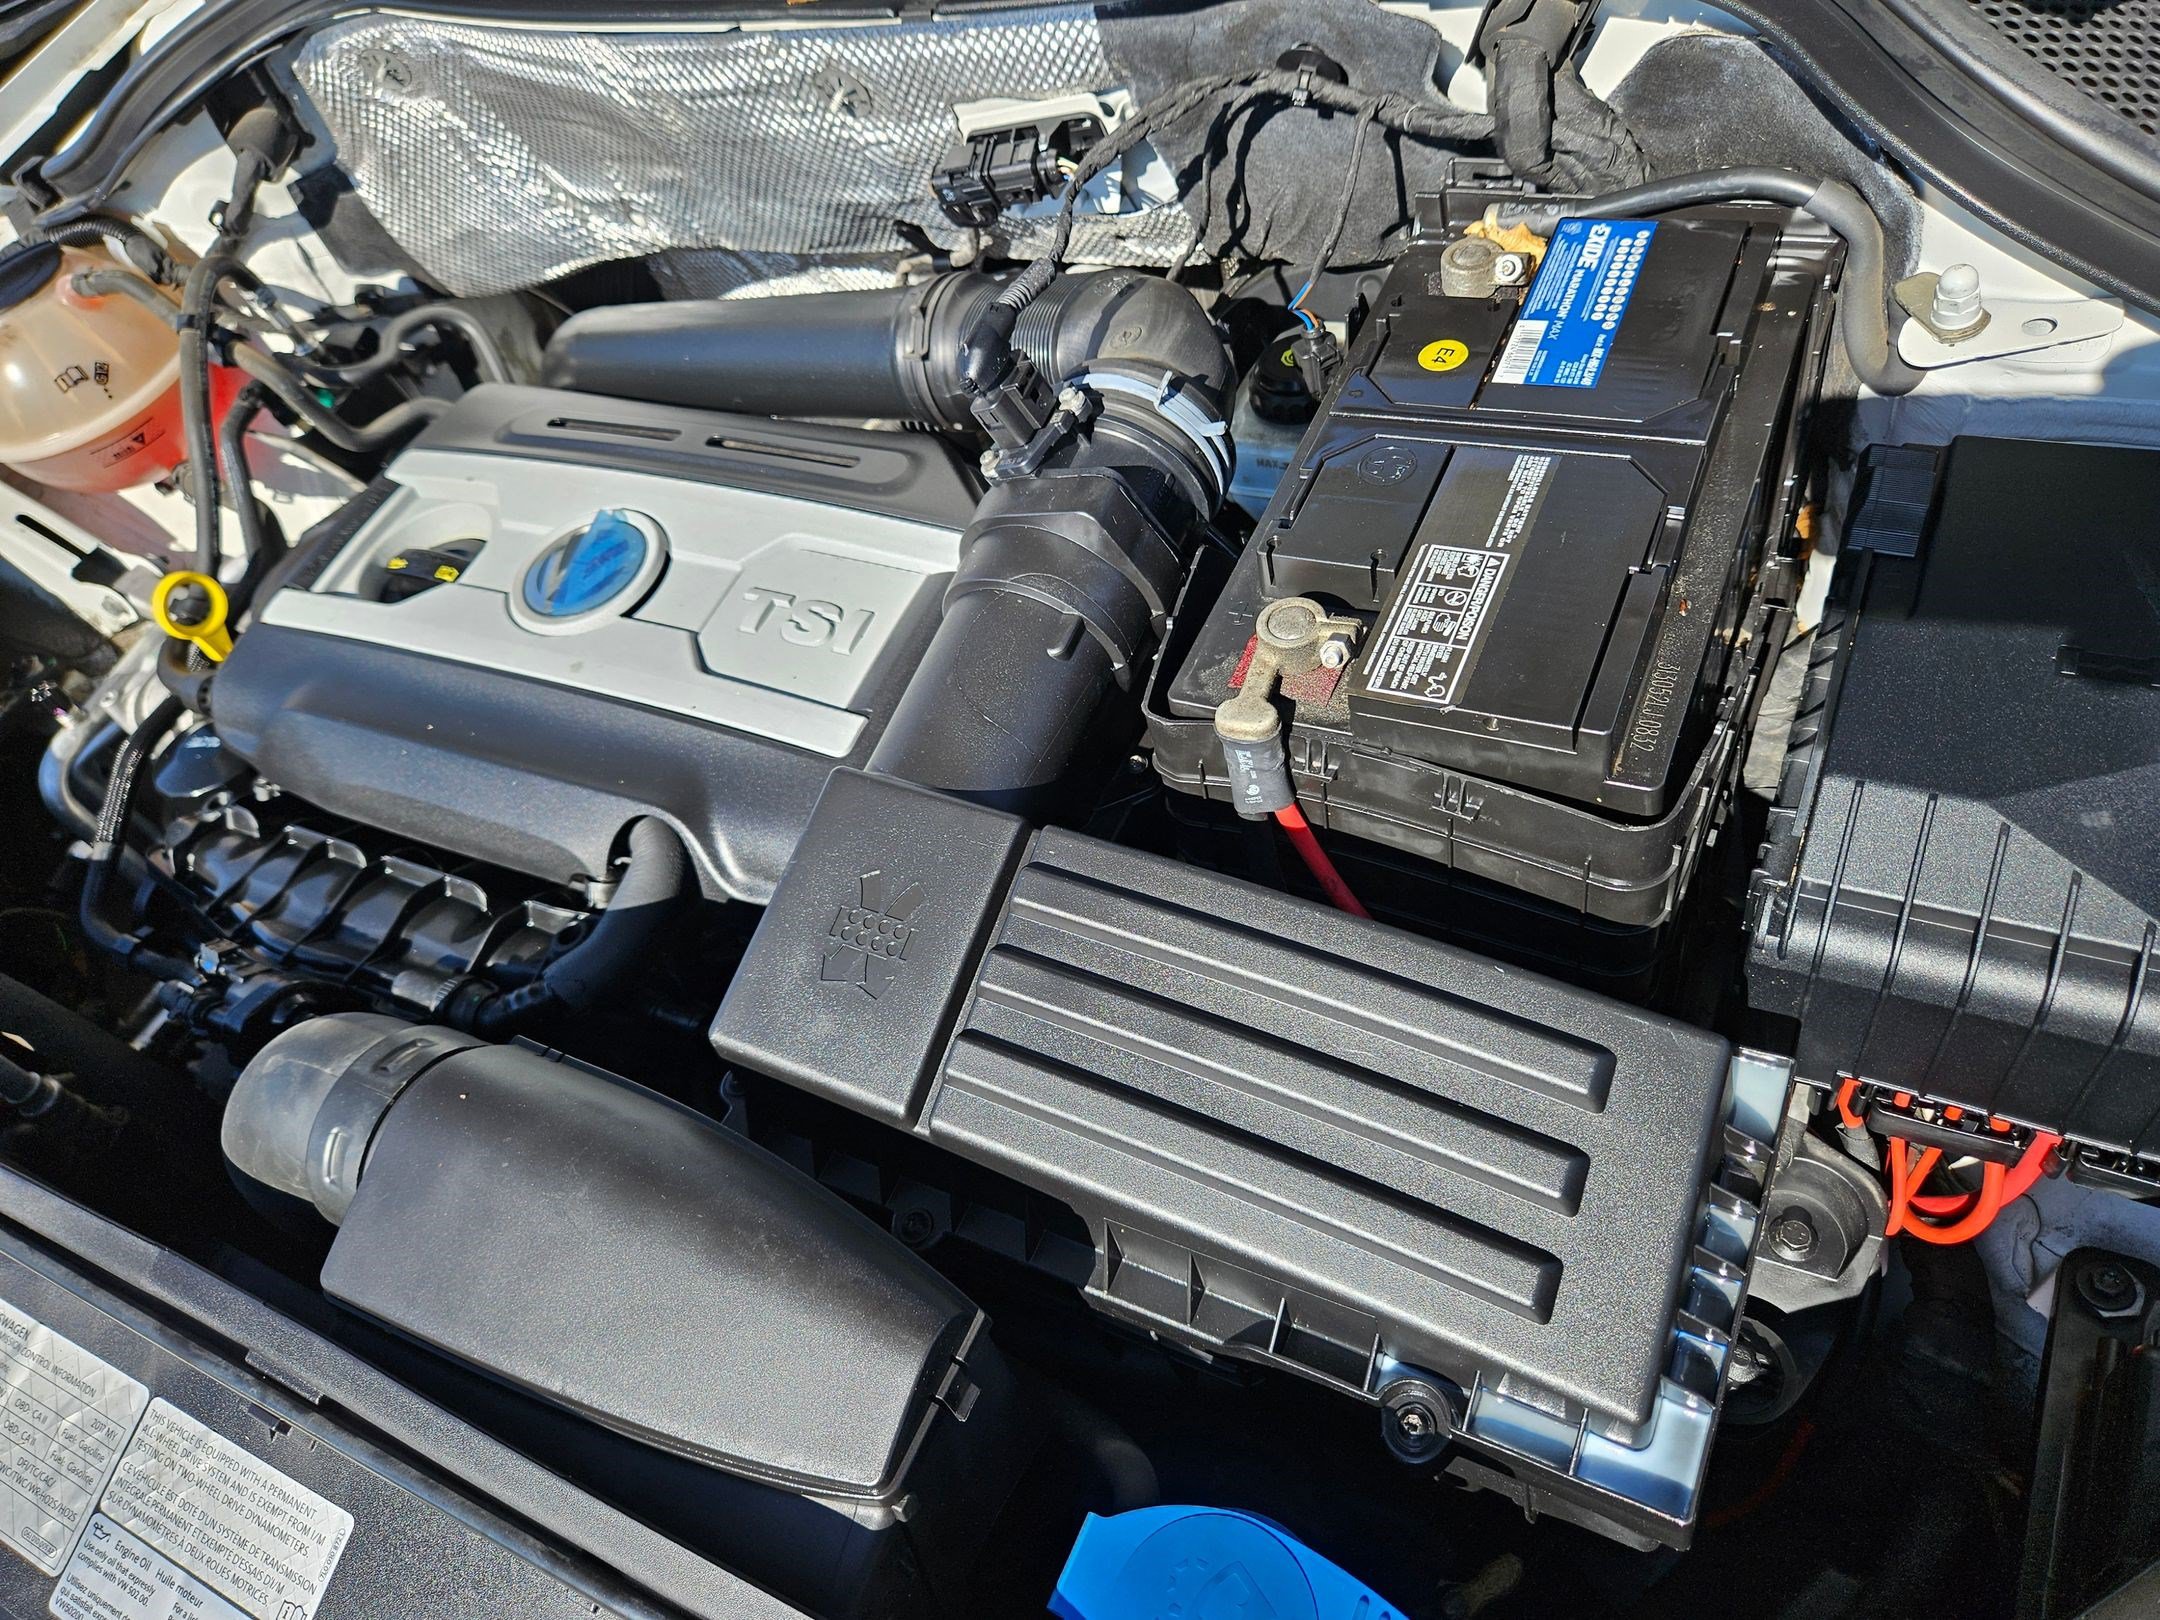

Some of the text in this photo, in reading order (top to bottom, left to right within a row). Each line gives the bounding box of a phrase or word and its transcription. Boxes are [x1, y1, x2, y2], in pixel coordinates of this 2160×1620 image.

[1574, 223, 1613, 270] EXIDE
[1546, 320, 1564, 339] MAX
[1431, 346, 1455, 364] E4
[740, 586, 875, 656] TSI
[1455, 567, 1496, 640] DANGER/POISON
[50, 1364, 96, 1398] INFORMATION
[30, 1408, 43, 1421] CA
[60, 1427, 78, 1445] Fuel:
[77, 1438, 106, 1463] Gasoline
[90, 1417, 118, 1442] 2017 MY
[49, 1449, 67, 1467] Fuel:
[65, 1460, 95, 1486] Gasoline
[141, 1423, 326, 1547] ALL-WHEEL DRIVE SYSTEM AND IS EXEMPT FROM I/M
[148, 1408, 316, 1520] THIS VEHICLE IS EQUIPPED WITH A PERMANENT
[133, 1437, 311, 1558] TESTING ON TWO-WHEEL DRIVE DYNAMOMETERS.
[149, 1499, 193, 1534] PERMANENT
[190, 1526, 203, 1540] ET
[106, 1489, 124, 1507] SUR
[183, 1541, 207, 1563] DEUX
[204, 1554, 232, 1581] ROUES
[229, 1571, 271, 1607] MOTRICES.
[121, 1460, 135, 1475] CE
[164, 1488, 179, 1504] EST
[247, 1542, 261, 1558] DE
[258, 1549, 317, 1595] TRANSMISSION
[76, 1550, 104, 1574] complies
[101, 1568, 118, 1584] with
[114, 1577, 128, 1592] VW
[125, 1585, 140, 1600] 502
[82, 1538, 156, 1597] Use only oil that expressly
[112, 1539, 204, 1609] Engine Oil Huile moteur
[59, 1583, 71, 1597] qui
[68, 1591, 94, 1614] satisfait
[65, 1572, 89, 1595] Utilisez
[85, 1588, 123, 1620] uniquement
[172, 1602, 184, 1615] For
